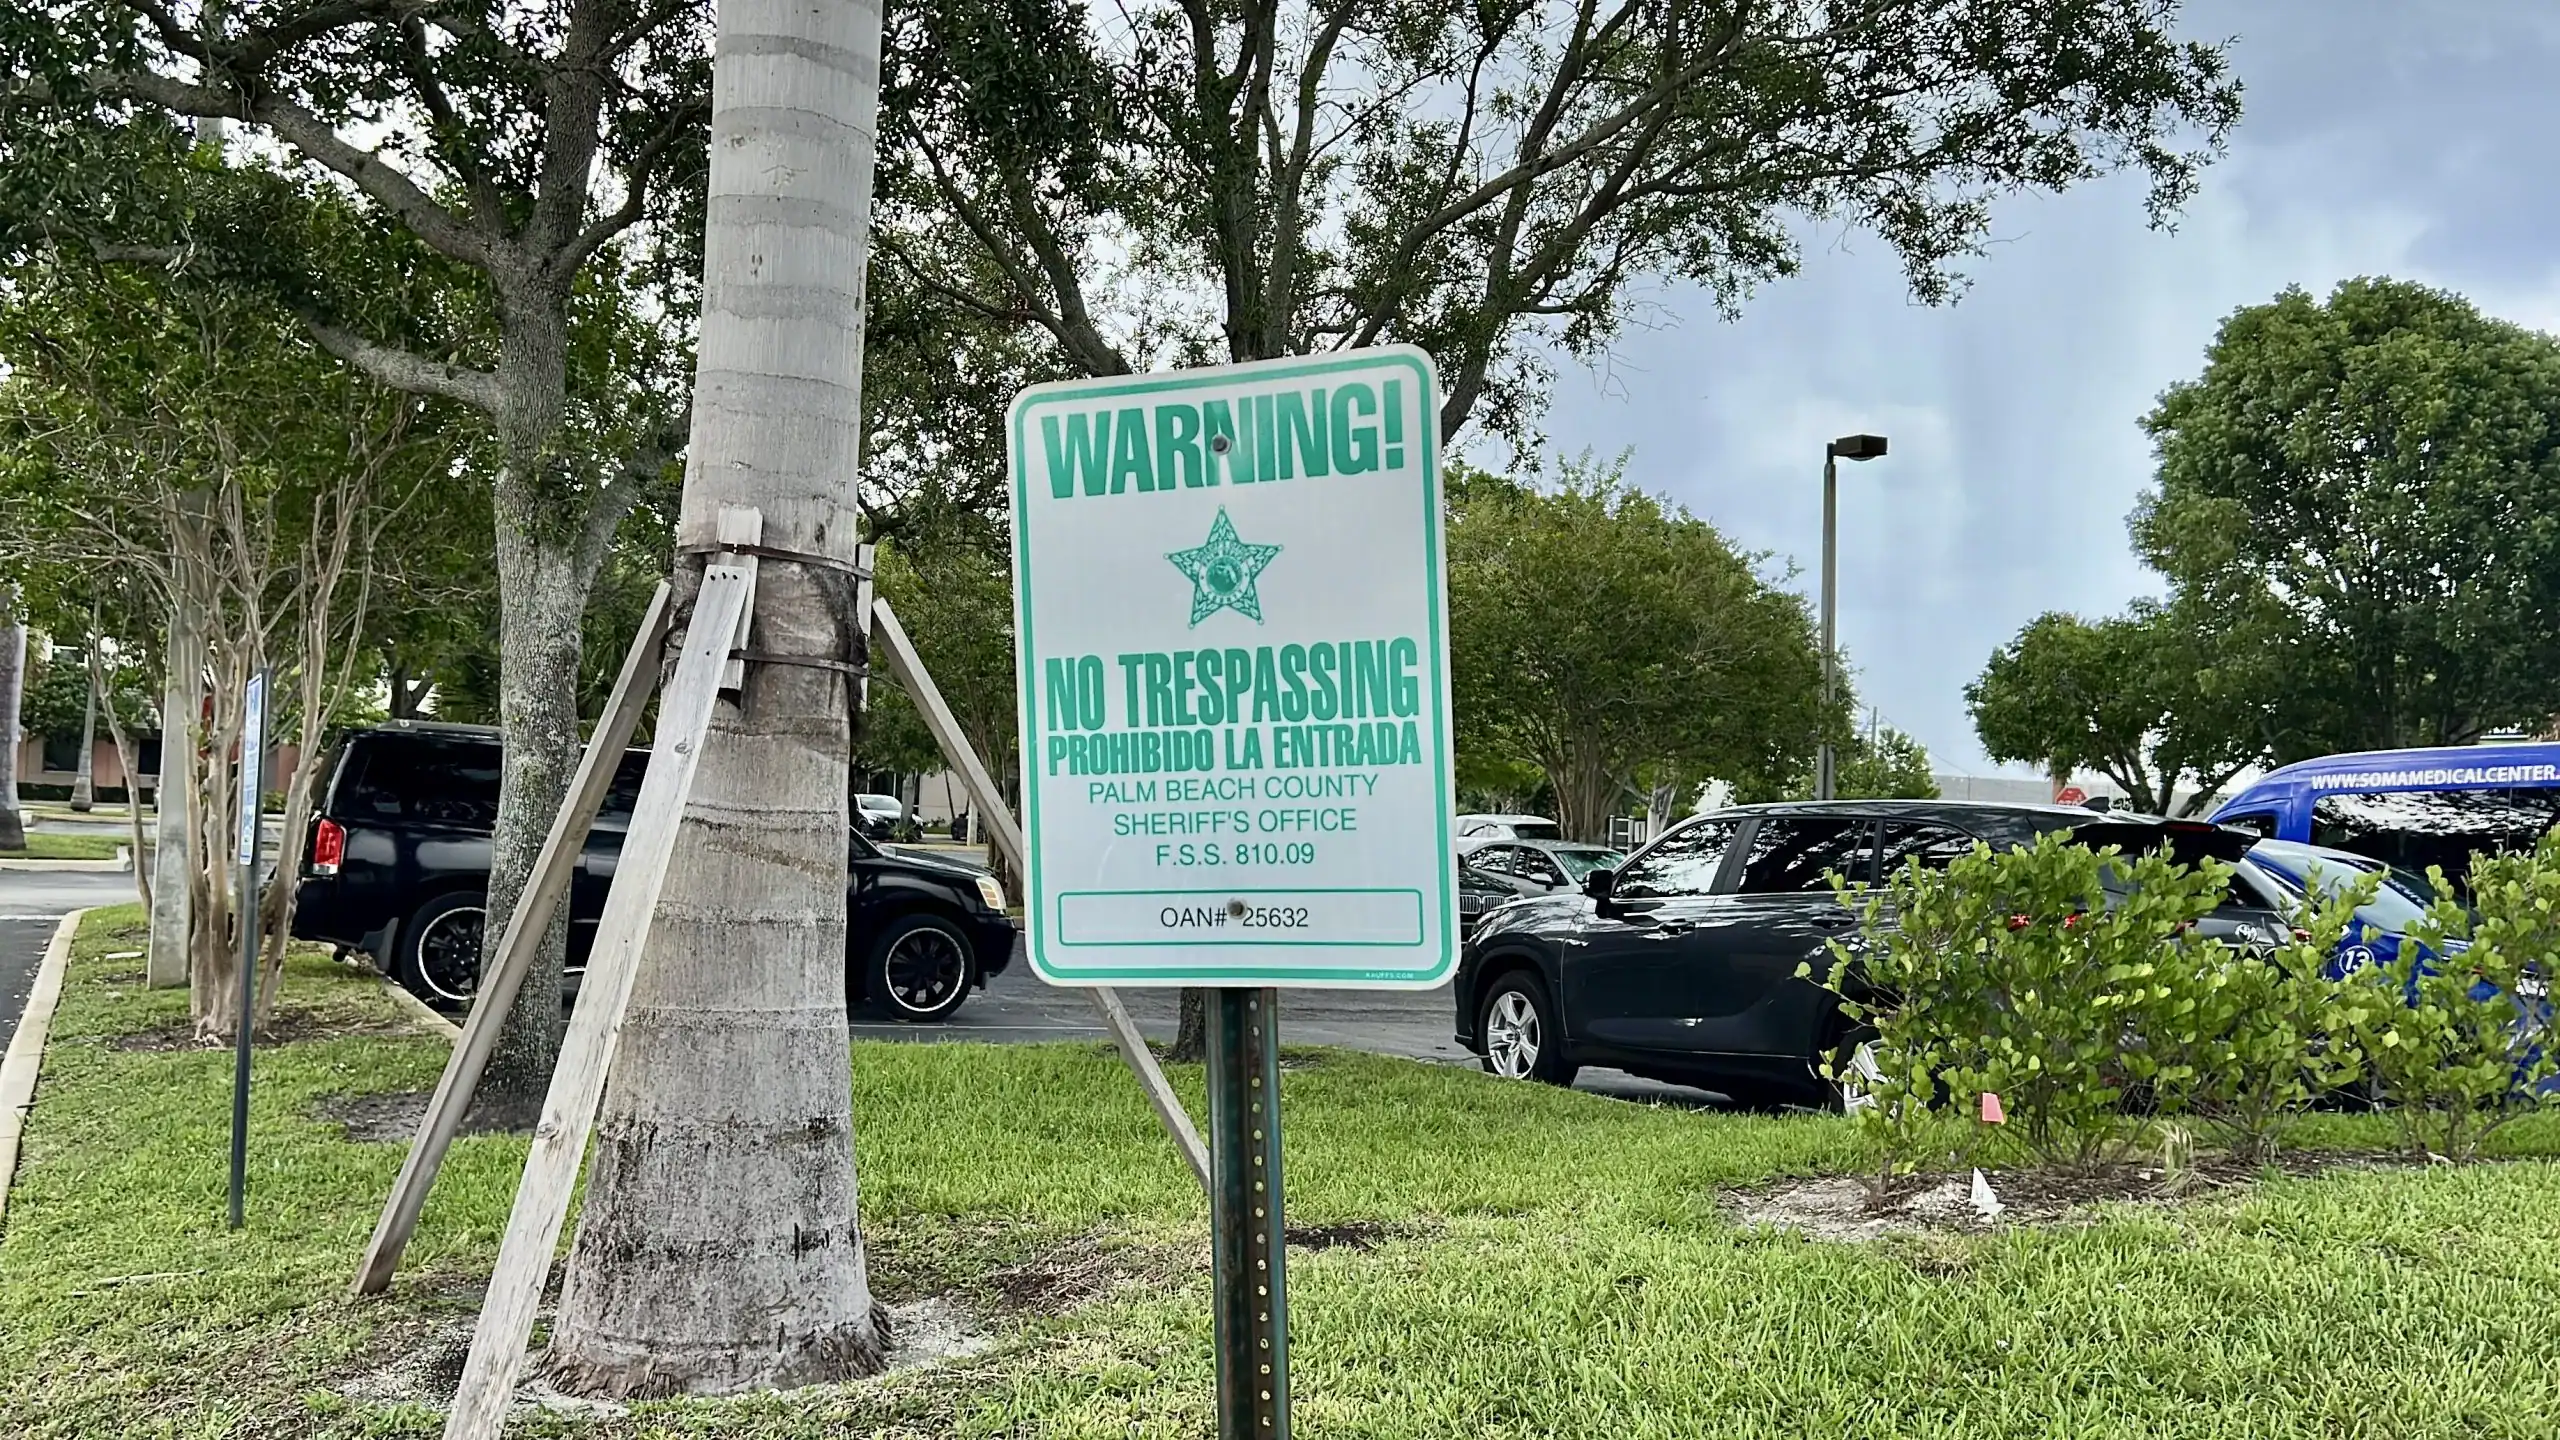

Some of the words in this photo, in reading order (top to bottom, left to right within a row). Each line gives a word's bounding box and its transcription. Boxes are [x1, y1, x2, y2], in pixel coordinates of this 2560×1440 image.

[1041, 380, 1404, 499] WARNING!
[1046, 655, 1107, 731] NO
[1118, 637, 1420, 728] TRESPASSING
[1049, 730, 1215, 775] PROHIBIDO
[1225, 727, 1263, 770] LA
[1274, 721, 1422, 768] ENTRADA
[1089, 782, 1156, 803] PALM
[1166, 778, 1255, 801] BEACH
[1264, 774, 1378, 798] COUNTY
[1114, 811, 1250, 836] SHERIFF'S
[1258, 808, 1357, 832] OFFICE
[1156, 844, 1227, 866] F.S.S.
[1236, 842, 1315, 865] 810.09
[1160, 907, 1227, 928] OAN#
[1243, 907, 1309, 928] 25632
